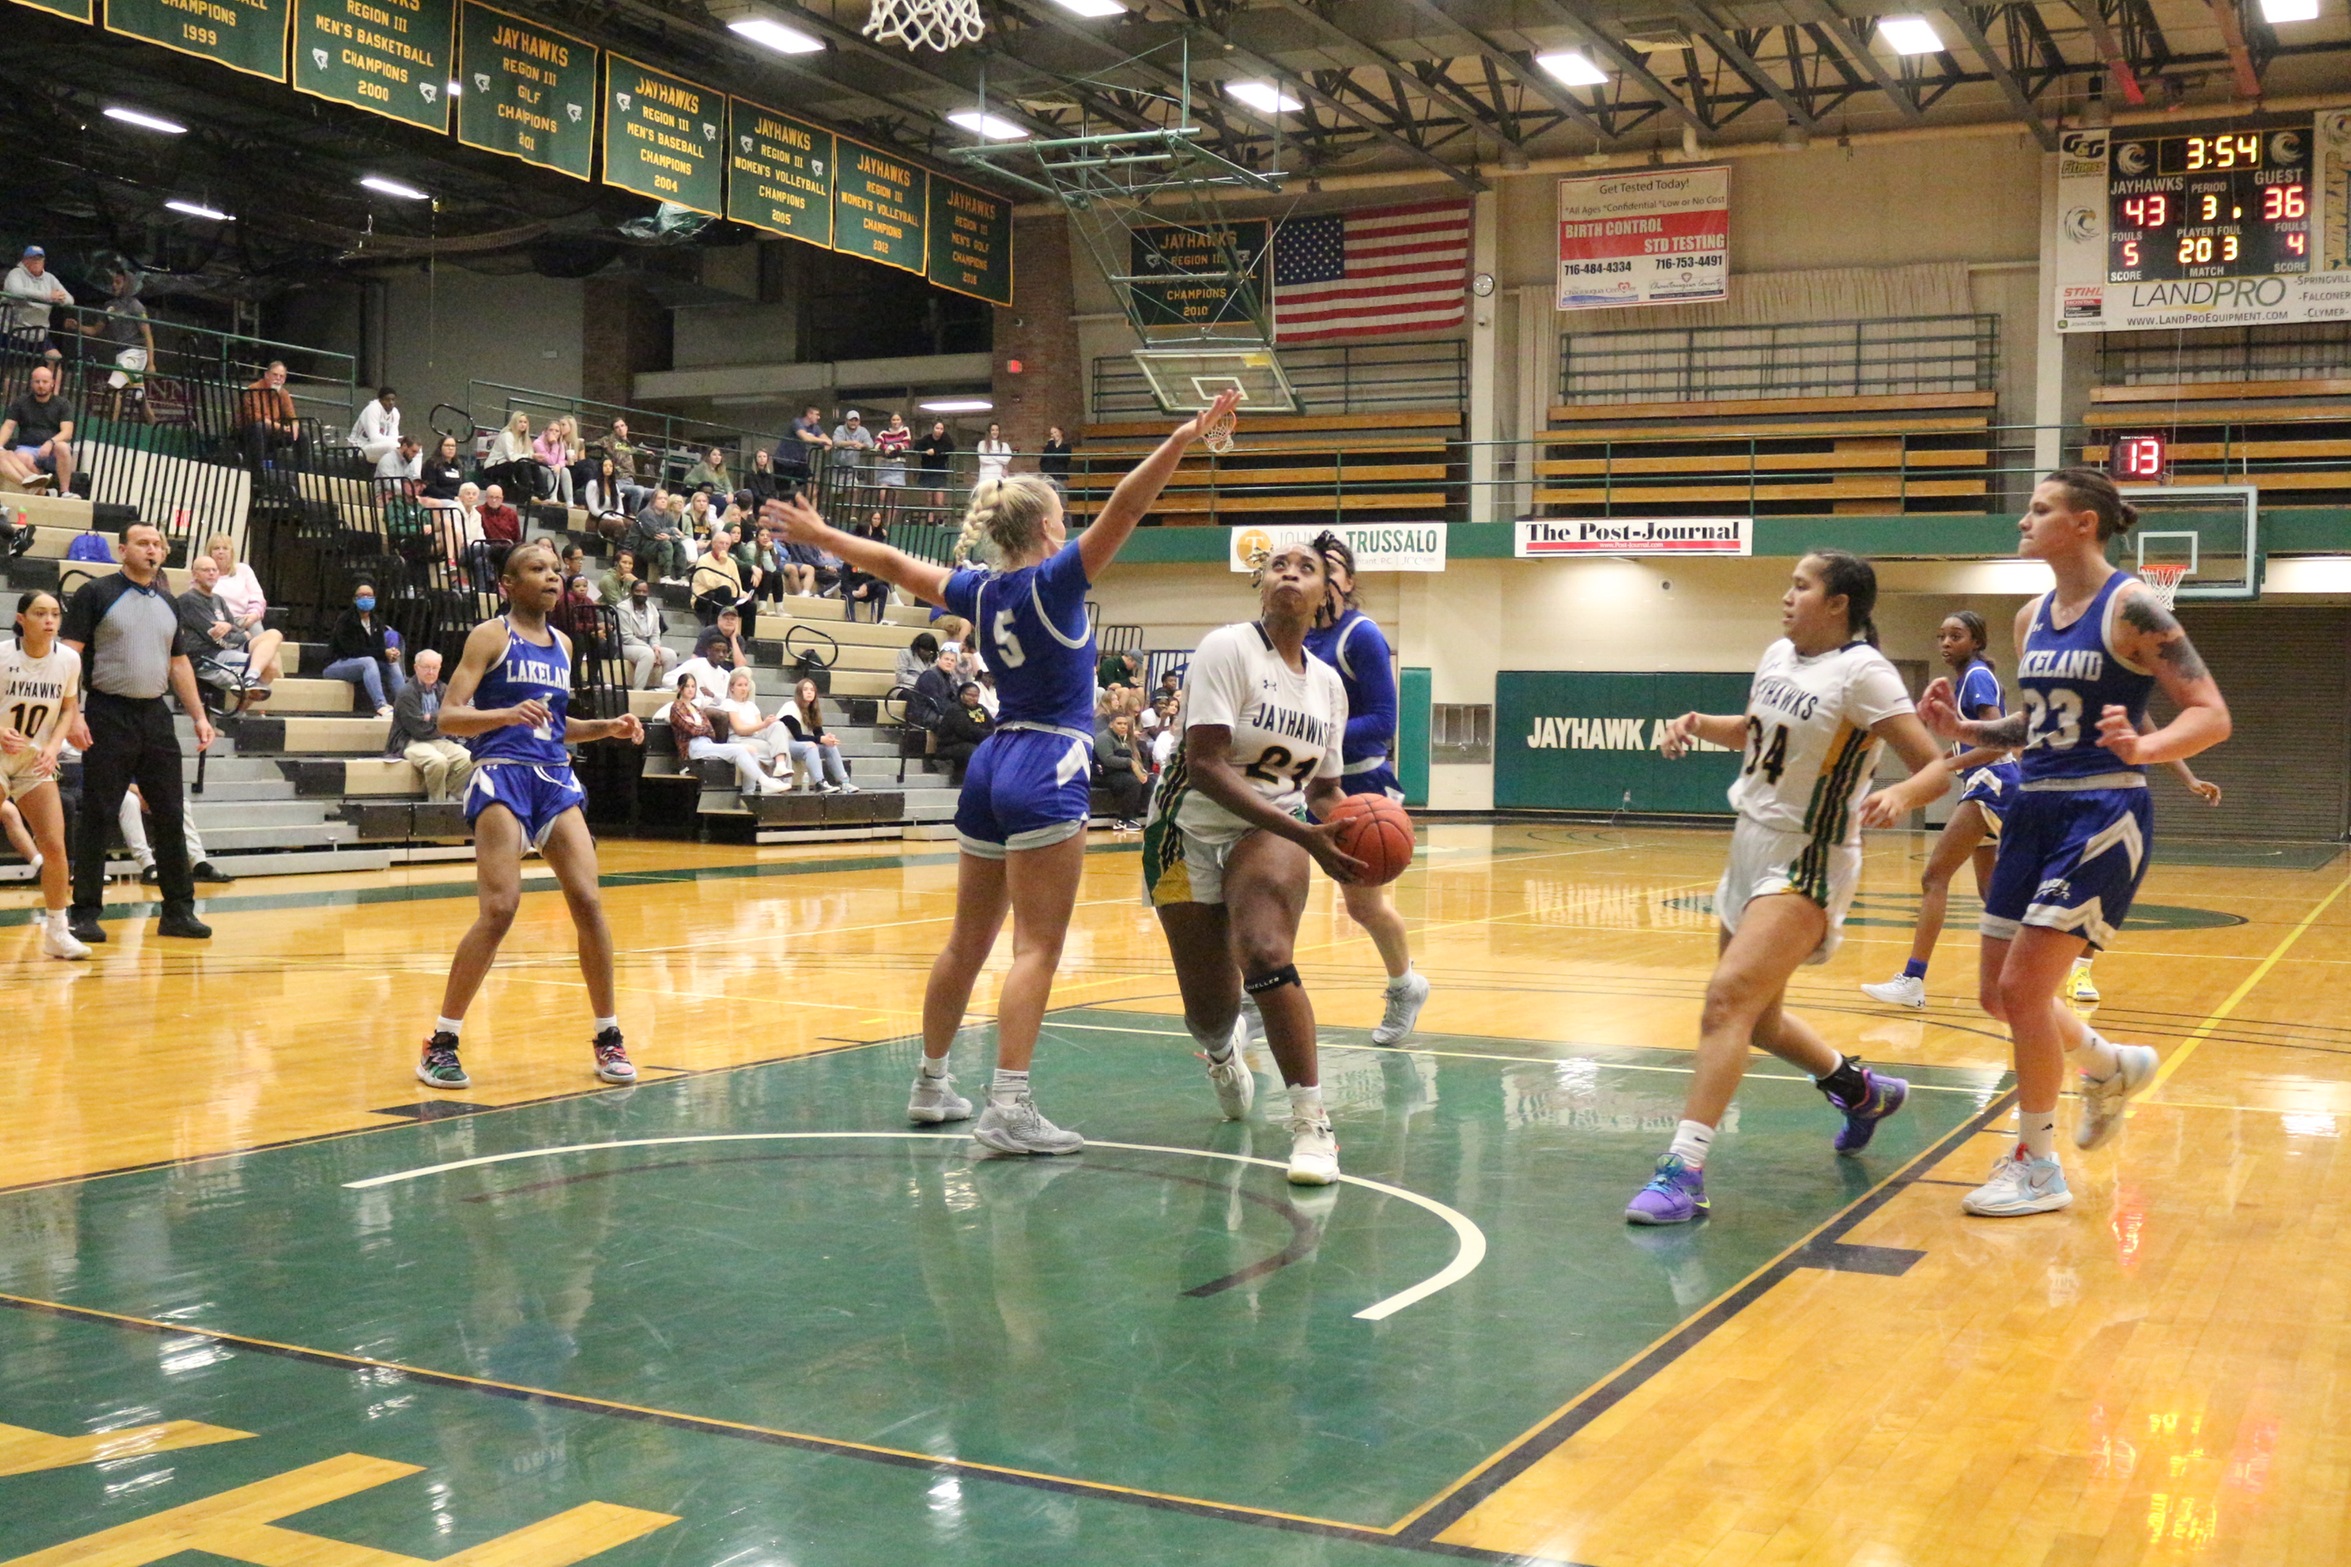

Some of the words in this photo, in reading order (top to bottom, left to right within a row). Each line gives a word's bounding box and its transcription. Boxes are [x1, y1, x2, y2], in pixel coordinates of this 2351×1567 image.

[347, 0, 390, 26] REGION
[394, 15, 408, 33] III
[182, 23, 218, 46] 1999
[316, 14, 353, 39] MEN'S
[357, 28, 435, 67] BASKETBALL
[492, 25, 569, 67] JAYHAWKS
[342, 49, 409, 83] CHAMPIONS
[503, 57, 540, 81] REGON
[544, 70, 557, 86] III
[358, 80, 390, 102] 2000
[635, 77, 700, 115] JAYHAWKS
[642, 105, 675, 127] REGION
[678, 117, 690, 132] III
[627, 121, 655, 142] MEN'S
[658, 132, 705, 159] BASEBALL
[754, 117, 812, 151] JAYHAWKS
[640, 148, 692, 176] CHAMPIONS
[761, 144, 791, 164] REGION
[794, 155, 804, 169] III
[2186, 134, 2258, 170] 3:54
[734, 156, 771, 178] WOMEN'S
[775, 169, 827, 196] VOLLEYBALL
[857, 154, 912, 188] JAYHAWKS
[2254, 169, 2304, 185] GUEST
[654, 174, 679, 193] 2004
[866, 180, 892, 199] REGION
[1599, 183, 1619, 195] Get
[1621, 179, 1654, 194] Tested
[1655, 177, 1690, 192] Today!
[2110, 177, 2184, 195] JAYHAWKS
[2191, 182, 2227, 194] PERIOD
[758, 185, 806, 210] CHAMPIONS
[841, 191, 874, 212] WOMEN'S
[876, 203, 920, 228] VOLLEYBALL
[947, 190, 997, 220] JAYHAWKS
[1581, 205, 1602, 217] Ages
[1682, 199, 1691, 207] or
[1692, 198, 1705, 206] No
[1706, 195, 1725, 205] Cost
[2202, 195, 2217, 220] 3
[2264, 186, 2306, 220] 36
[771, 209, 792, 226] 2005
[2125, 195, 2167, 227] 43
[863, 217, 903, 240] CHAMPIONS
[1565, 222, 1603, 239] BIRTH
[1605, 217, 1663, 236] CONTROL
[2111, 231, 2143, 241] FOULS
[2176, 227, 2214, 239] PLAYER
[2217, 225, 2242, 236] FOUL
[2274, 222, 2308, 232] FOULS
[1644, 238, 1670, 254] STD
[1672, 233, 1725, 251] TESTING
[2124, 242, 2139, 267] 5
[2178, 237, 2212, 264] 20
[2223, 236, 2238, 261] 3
[2287, 233, 2305, 255] 4
[952, 250, 989, 272] CHAMPIONS
[1170, 254, 1209, 267] REGION
[1564, 260, 1632, 276] 716-484-4334
[1655, 254, 1723, 271] 716-753-4491
[2189, 266, 2225, 278] MATCH
[2274, 262, 2307, 273] SCORE
[2110, 271, 2142, 282] SCORE
[1166, 287, 1228, 302] CHAMPIONS
[2063, 287, 2103, 297] STIHL
[2132, 277, 2287, 308] LANDPRO
[1183, 305, 1209, 318] 2010
[2130, 440, 2159, 474] 13
[1346, 530, 1437, 553] TRUSSALO
[1526, 523, 1571, 541] The
[1579, 521, 1739, 541] Post-Journal
[993, 608, 1026, 669] 5
[6, 680, 62, 699] AYHAWKS
[10, 703, 48, 739] 10
[1252, 703, 1329, 748] JAYHAWKS
[2023, 688, 2083, 749] 23
[1527, 717, 1645, 751] JAYHAWK
[1246, 746, 1318, 790] 21
